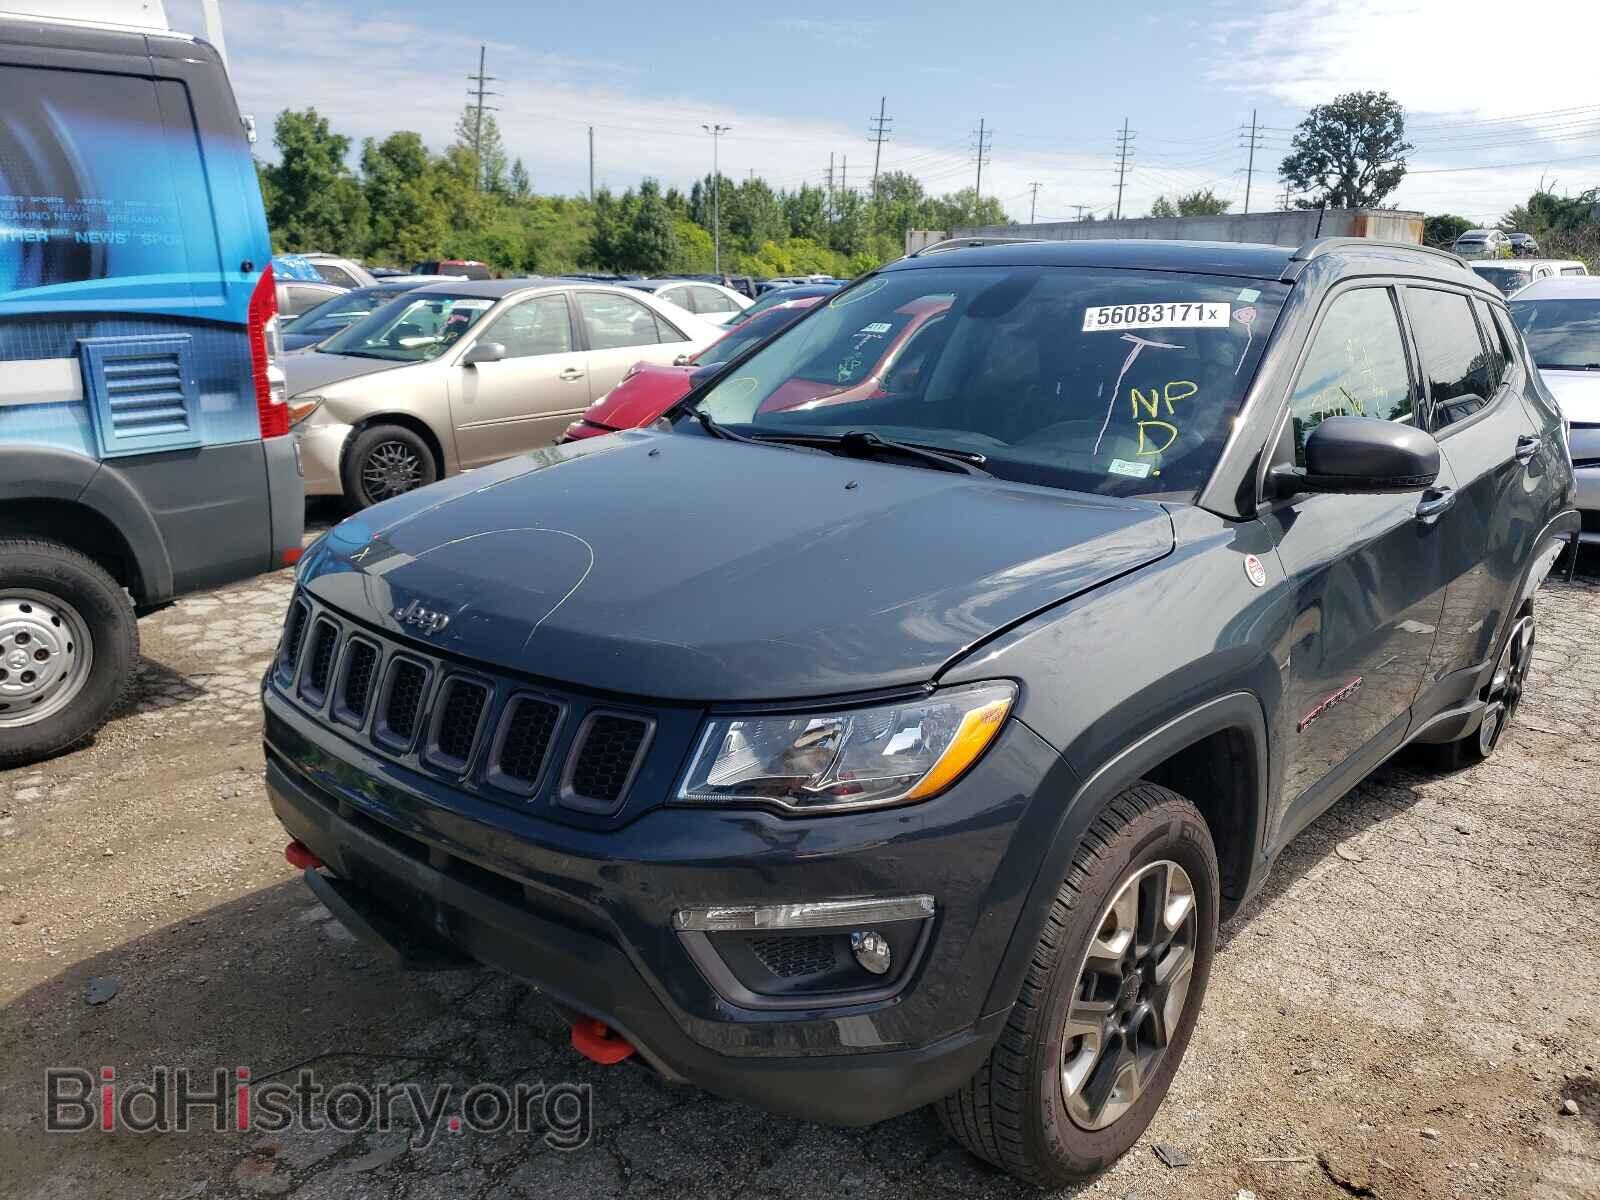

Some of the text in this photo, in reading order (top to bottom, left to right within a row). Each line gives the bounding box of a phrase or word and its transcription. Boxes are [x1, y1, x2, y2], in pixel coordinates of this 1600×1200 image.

[75, 231, 129, 245] NEWS
[1136, 420, 1178, 455] D
[393, 599, 450, 636] Jeep
